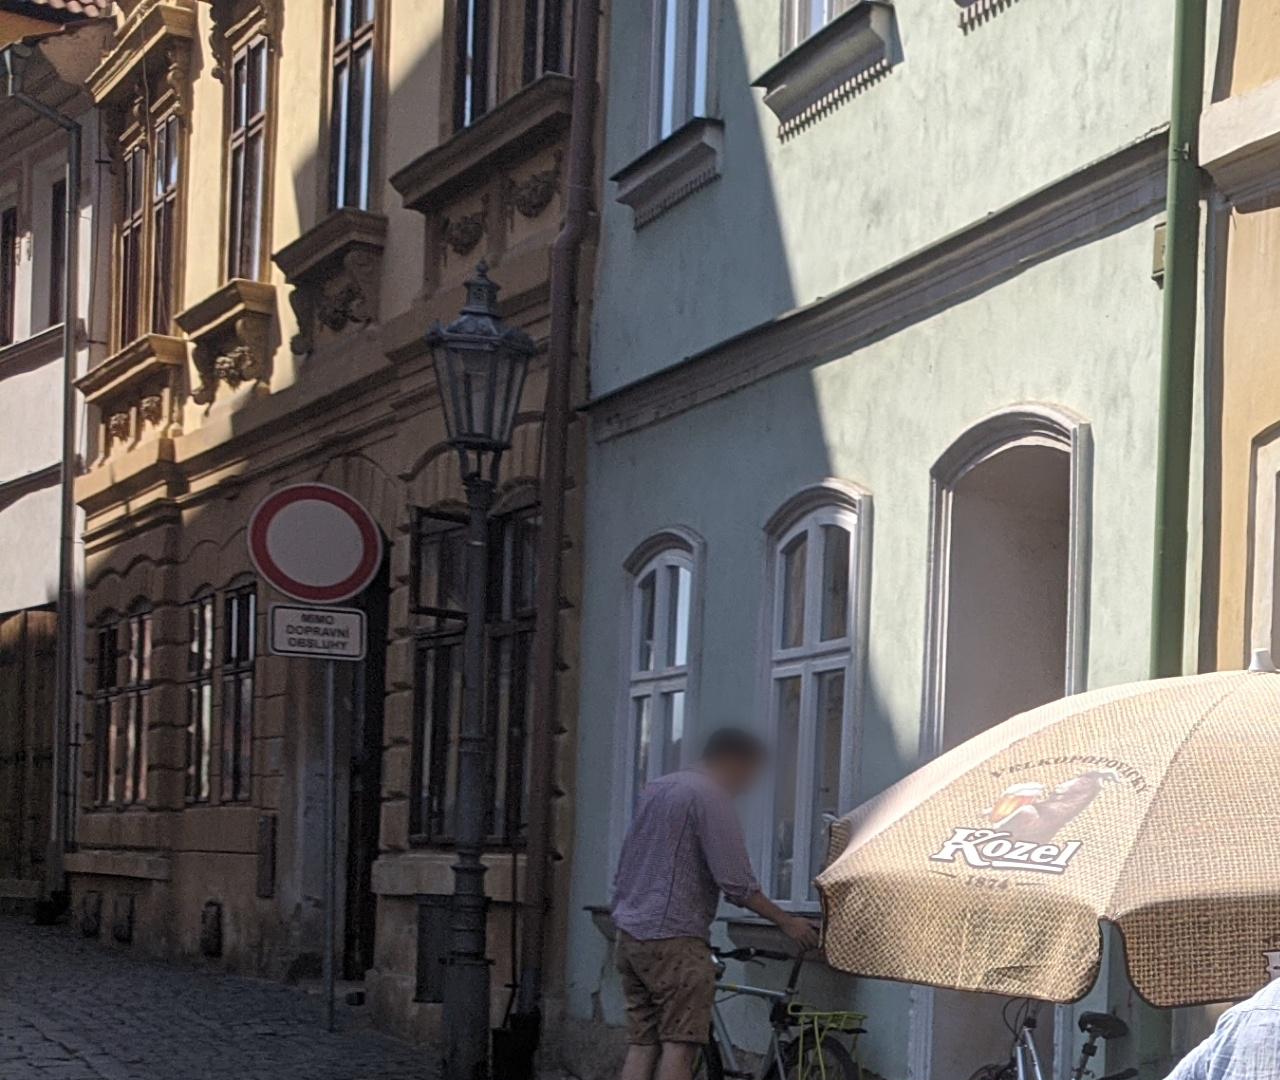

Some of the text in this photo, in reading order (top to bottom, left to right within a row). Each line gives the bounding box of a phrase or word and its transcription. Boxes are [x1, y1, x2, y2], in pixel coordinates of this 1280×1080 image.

[301, 613, 334, 625] MIMO
[288, 637, 349, 649] OBSLUHY
[929, 827, 1083, 874] Kozel
